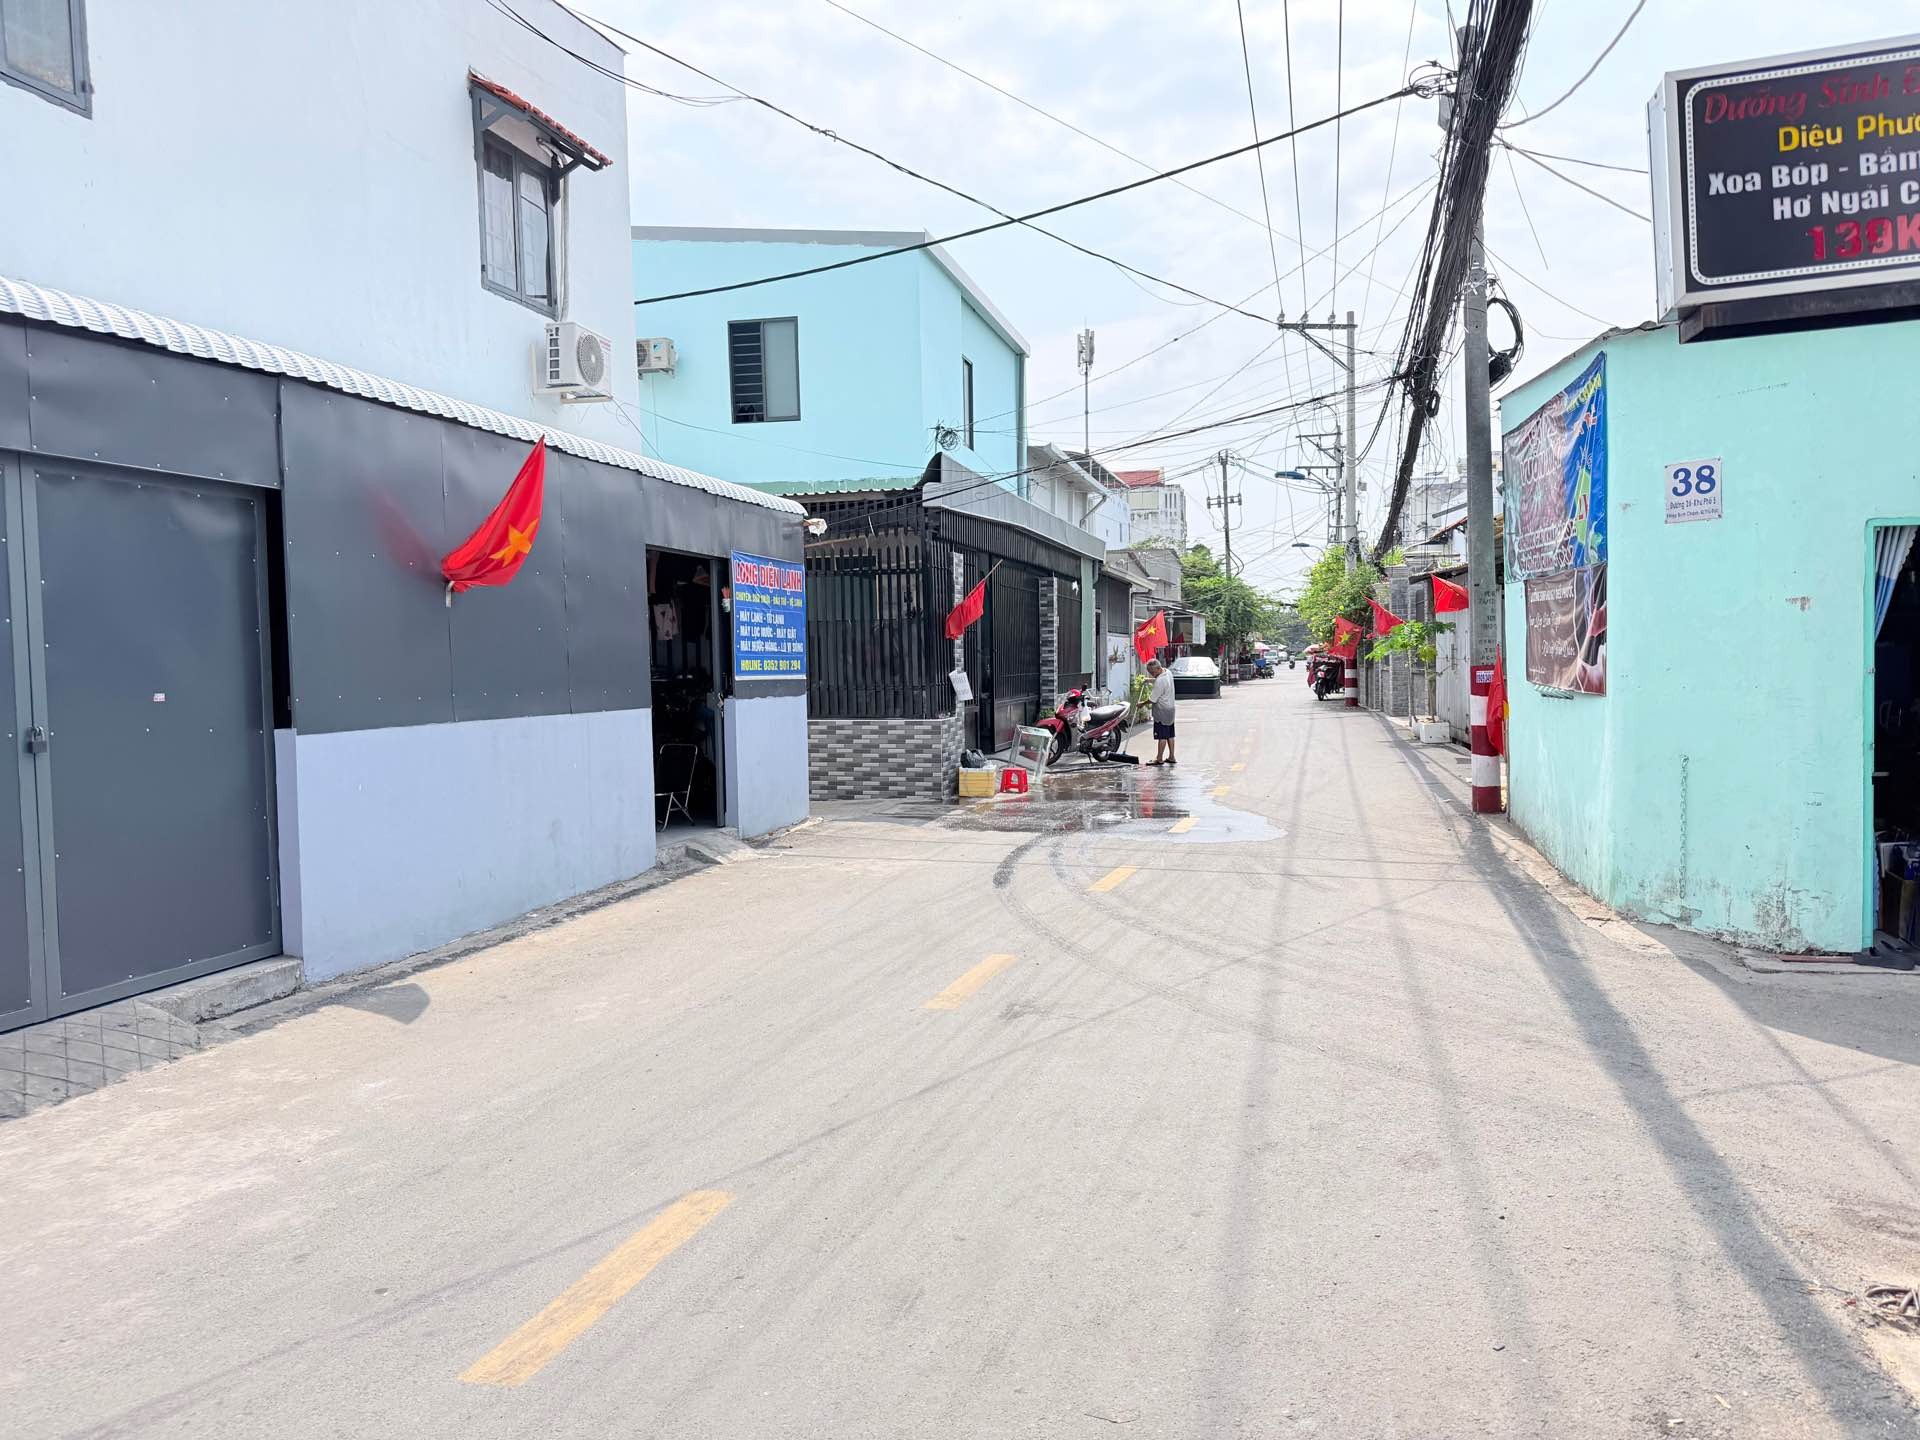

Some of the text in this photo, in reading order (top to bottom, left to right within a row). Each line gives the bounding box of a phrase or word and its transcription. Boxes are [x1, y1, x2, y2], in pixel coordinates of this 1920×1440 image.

[1818, 72, 1890, 110] Sinh
[1778, 123, 1843, 153] Diệu
[1707, 171, 1762, 196] Xoa
[1771, 161, 1829, 188] Bóp
[1772, 193, 1811, 221] Hơ
[1807, 211, 1920, 261] 139K
[1672, 465, 1716, 497] 38
[759, 562, 780, 593] ĐIỆN
[781, 568, 803, 596] LẠNH
